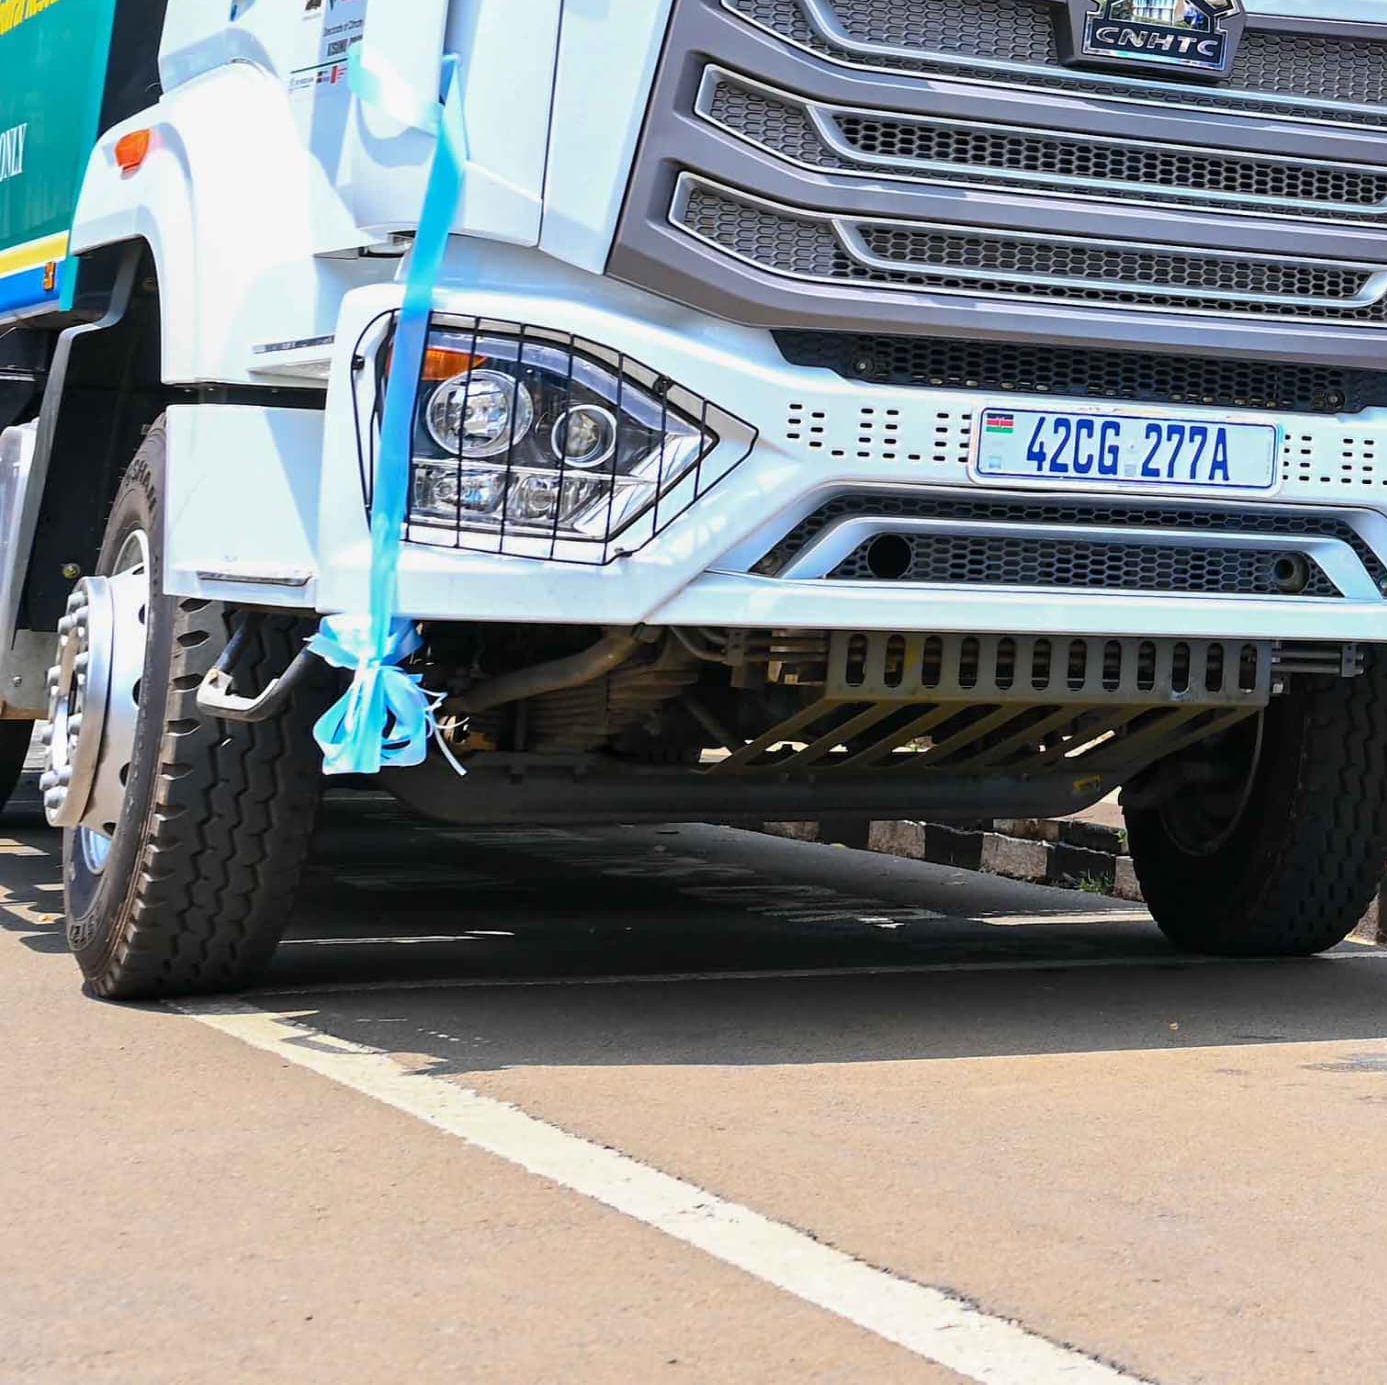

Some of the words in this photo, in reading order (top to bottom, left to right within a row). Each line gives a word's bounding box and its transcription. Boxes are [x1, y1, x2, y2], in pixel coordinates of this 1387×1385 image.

[1095, 26, 1219, 57] CNHTC
[1026, 415, 1121, 476] 42CG
[1140, 422, 1230, 482] 277A
